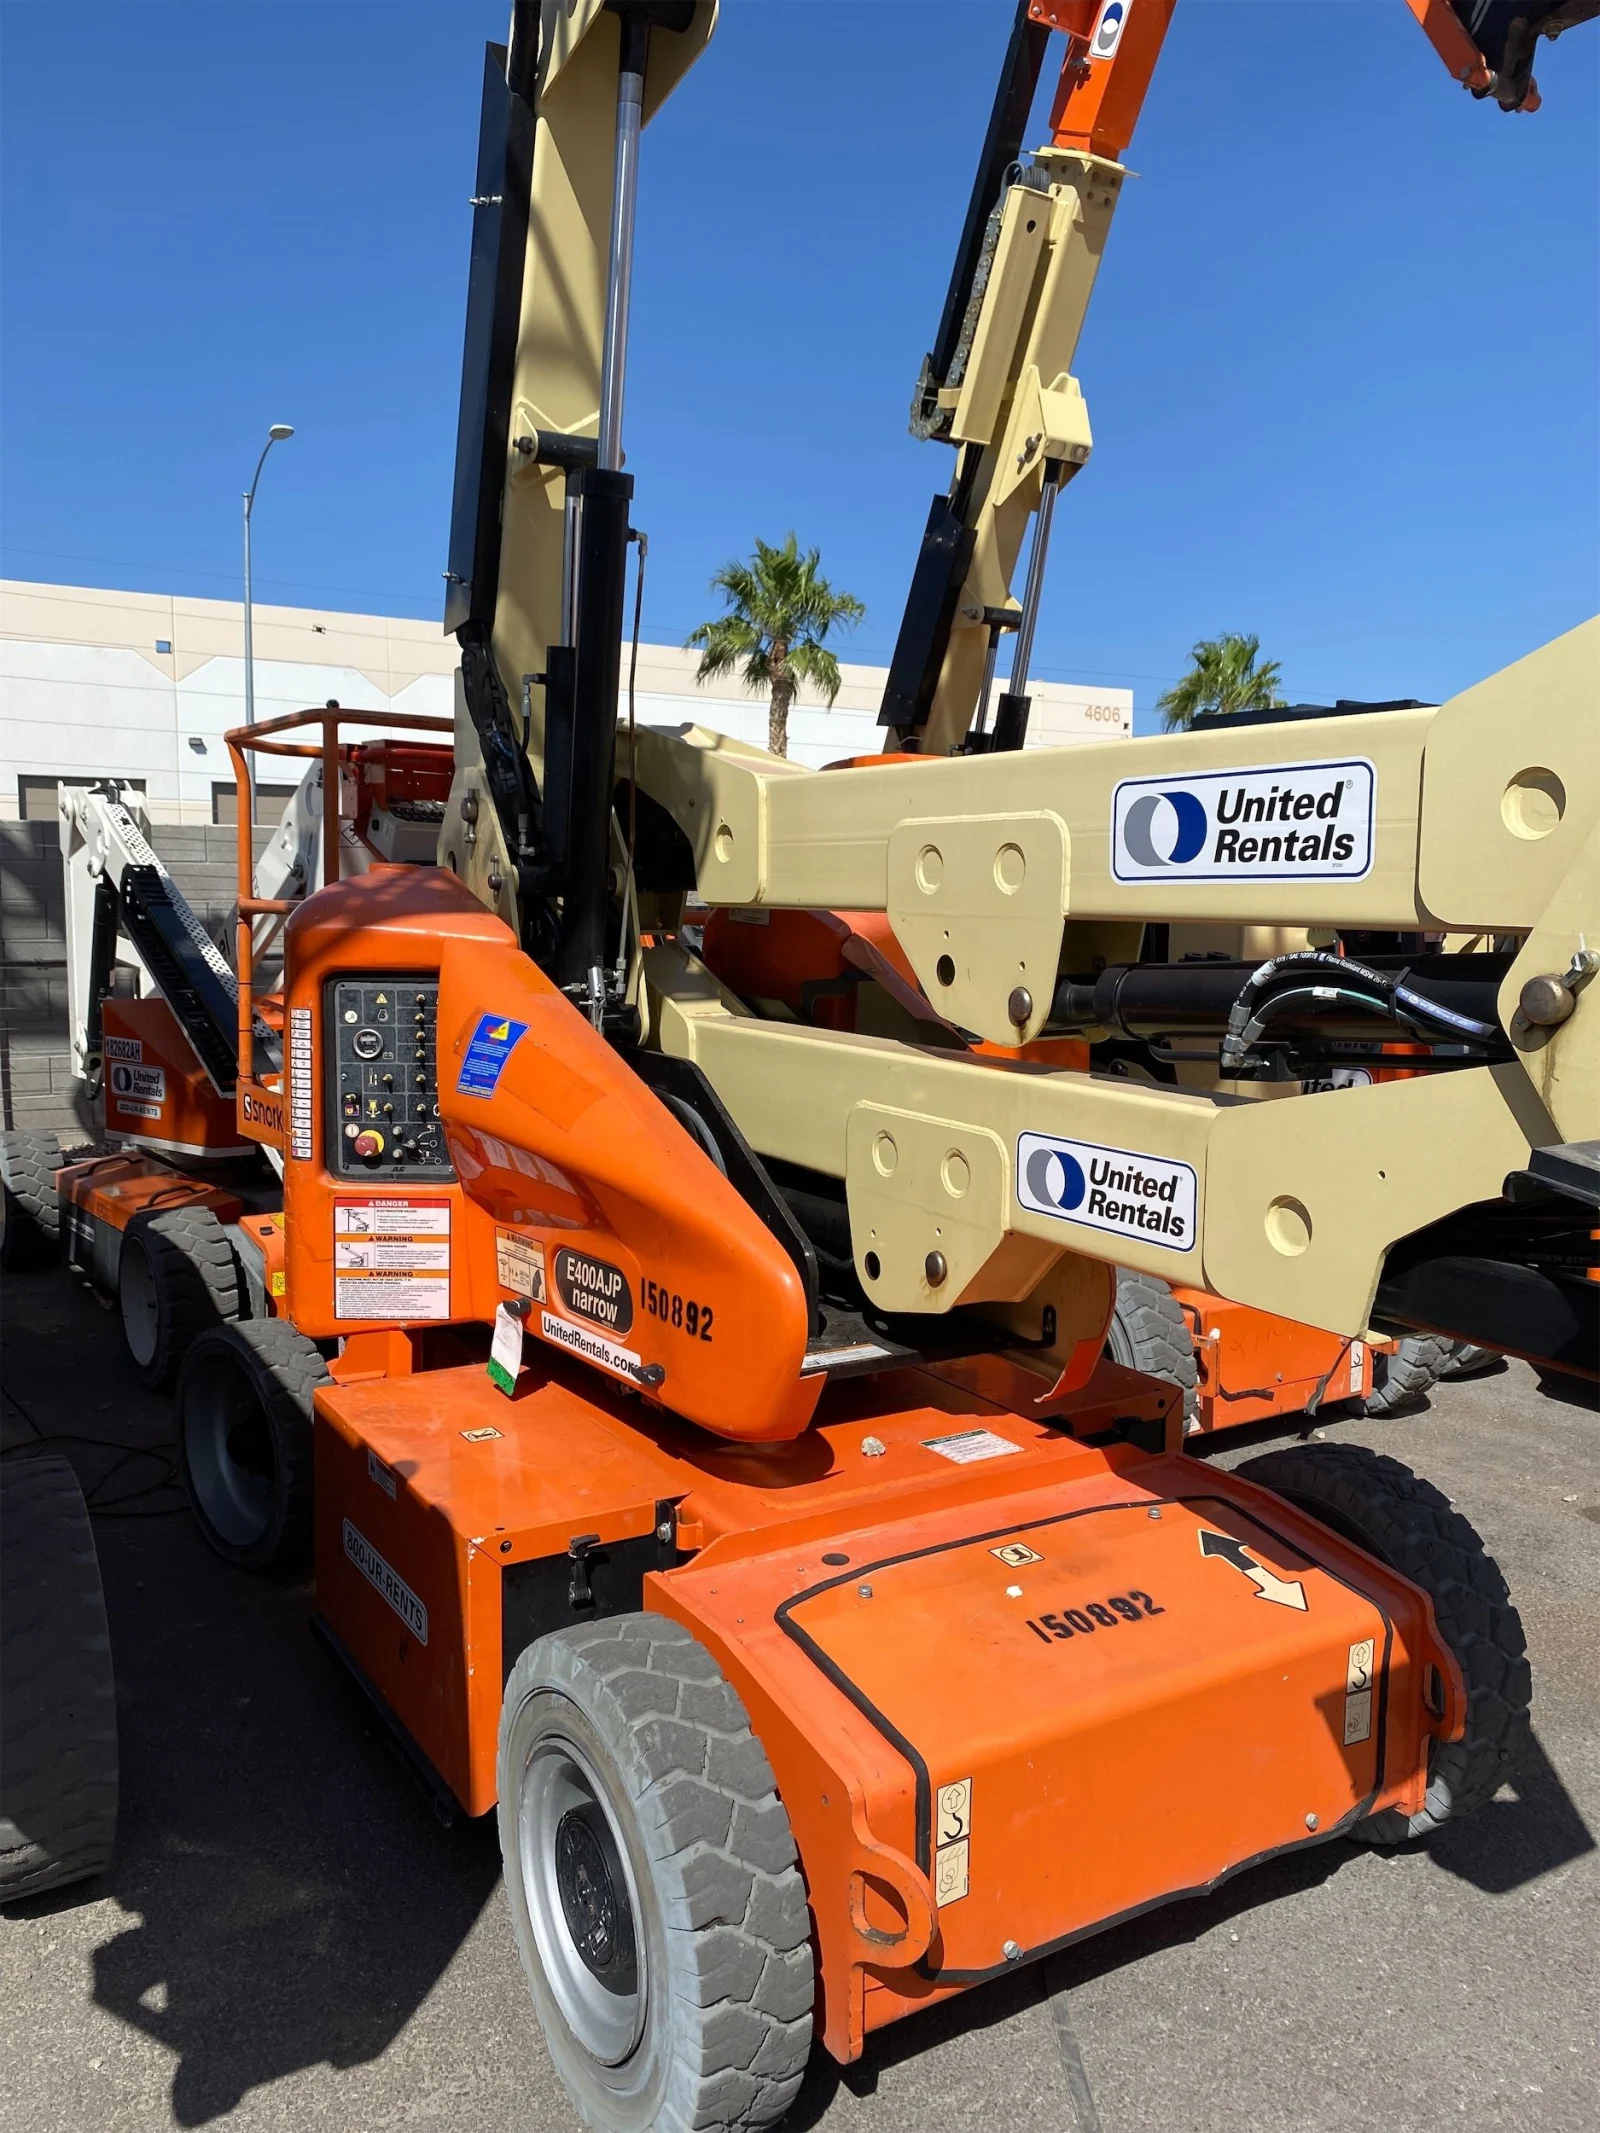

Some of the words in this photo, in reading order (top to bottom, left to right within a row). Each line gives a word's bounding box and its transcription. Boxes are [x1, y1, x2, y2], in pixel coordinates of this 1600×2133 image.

[1085, 705, 1121, 723] 4606
[1213, 824, 1355, 863] Rentals
[133, 1069, 160, 1084] United
[133, 1083, 163, 1098] Rentals
[252, 1100, 284, 1133] snork
[1087, 1188, 1185, 1237] Rentals
[566, 1256, 622, 1299] E400AJP
[572, 1286, 619, 1323] narrow
[640, 1276, 713, 1343] 150892
[346, 1529, 423, 1631] 800-UR-RENTS
[1025, 1590, 1166, 1644] 150892
